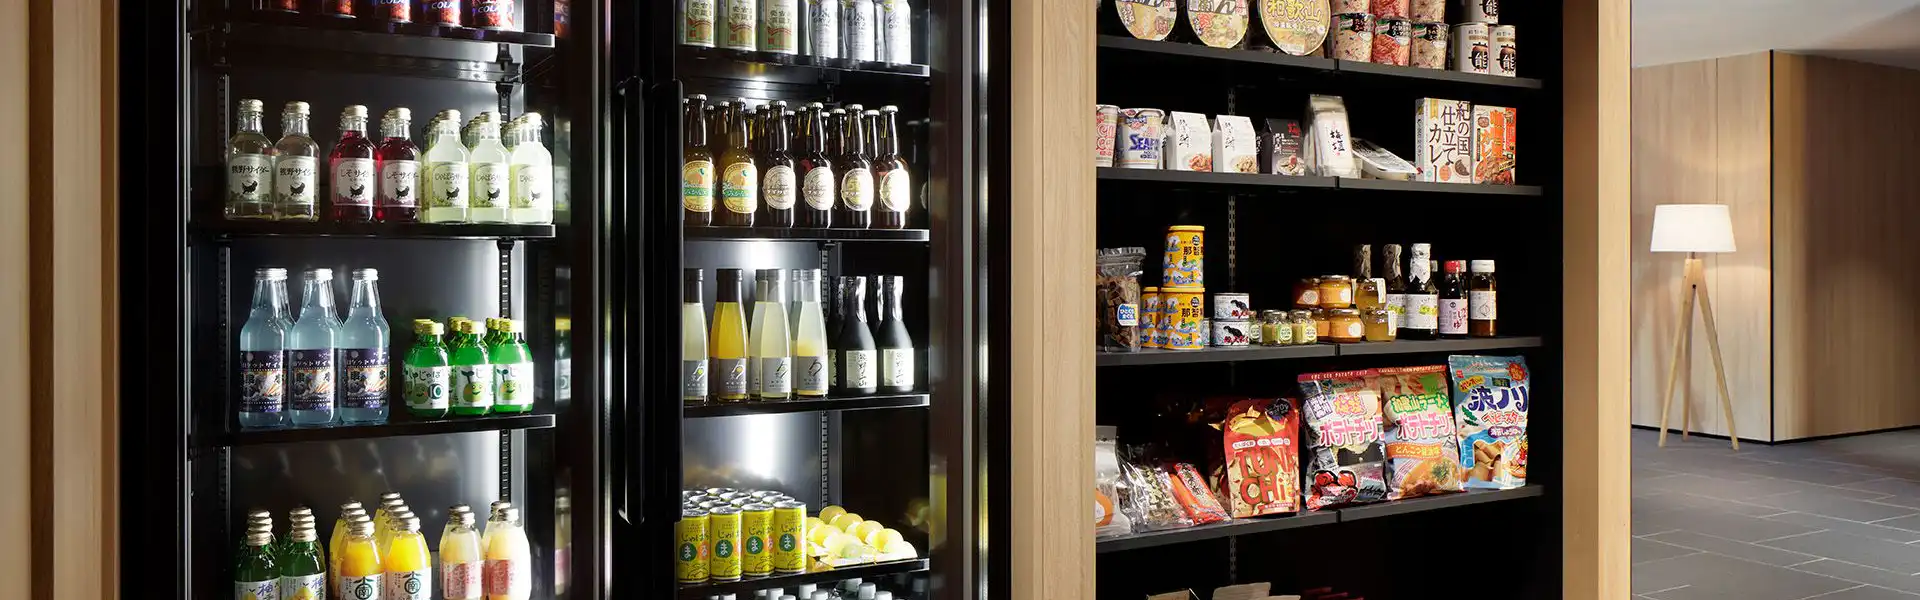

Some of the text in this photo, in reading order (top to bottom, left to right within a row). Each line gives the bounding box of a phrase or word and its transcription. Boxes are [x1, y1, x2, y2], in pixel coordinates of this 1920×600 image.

[1266, 0, 1321, 22] 和歌山
[1441, 105, 1457, 165] 仕立て
[1456, 100, 1471, 156] 紀の国
[1429, 123, 1443, 183] カレー
[1467, 386, 1528, 412] 波ノリ
[1481, 409, 1524, 425] ベビースター
